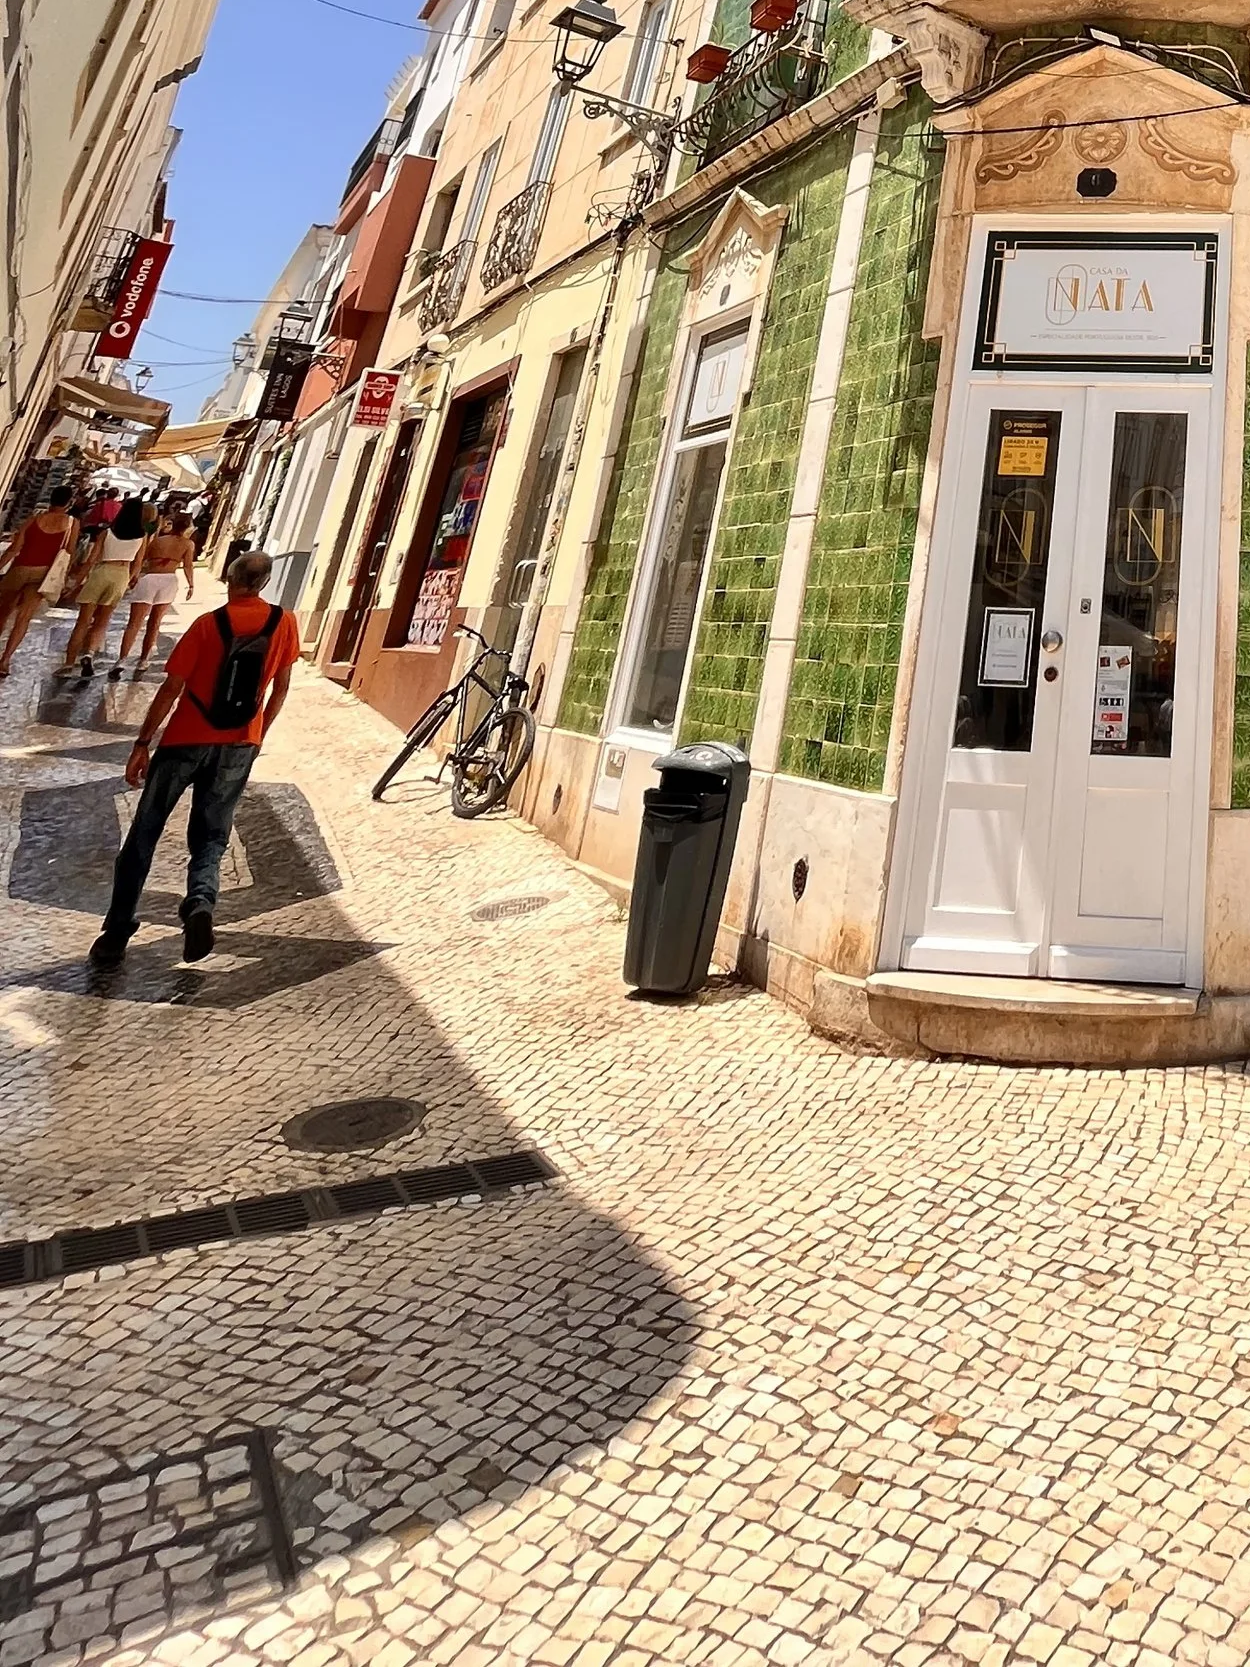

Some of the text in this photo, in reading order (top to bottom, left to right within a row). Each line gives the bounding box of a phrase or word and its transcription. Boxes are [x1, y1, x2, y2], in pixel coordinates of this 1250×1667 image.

[1089, 267, 1129, 276] CASA DA
[120, 257, 154, 318] vodafone
[1053, 277, 1154, 312] NATA
[279, 375, 293, 399] LAGOS
[264, 388, 279, 414] SUITES
